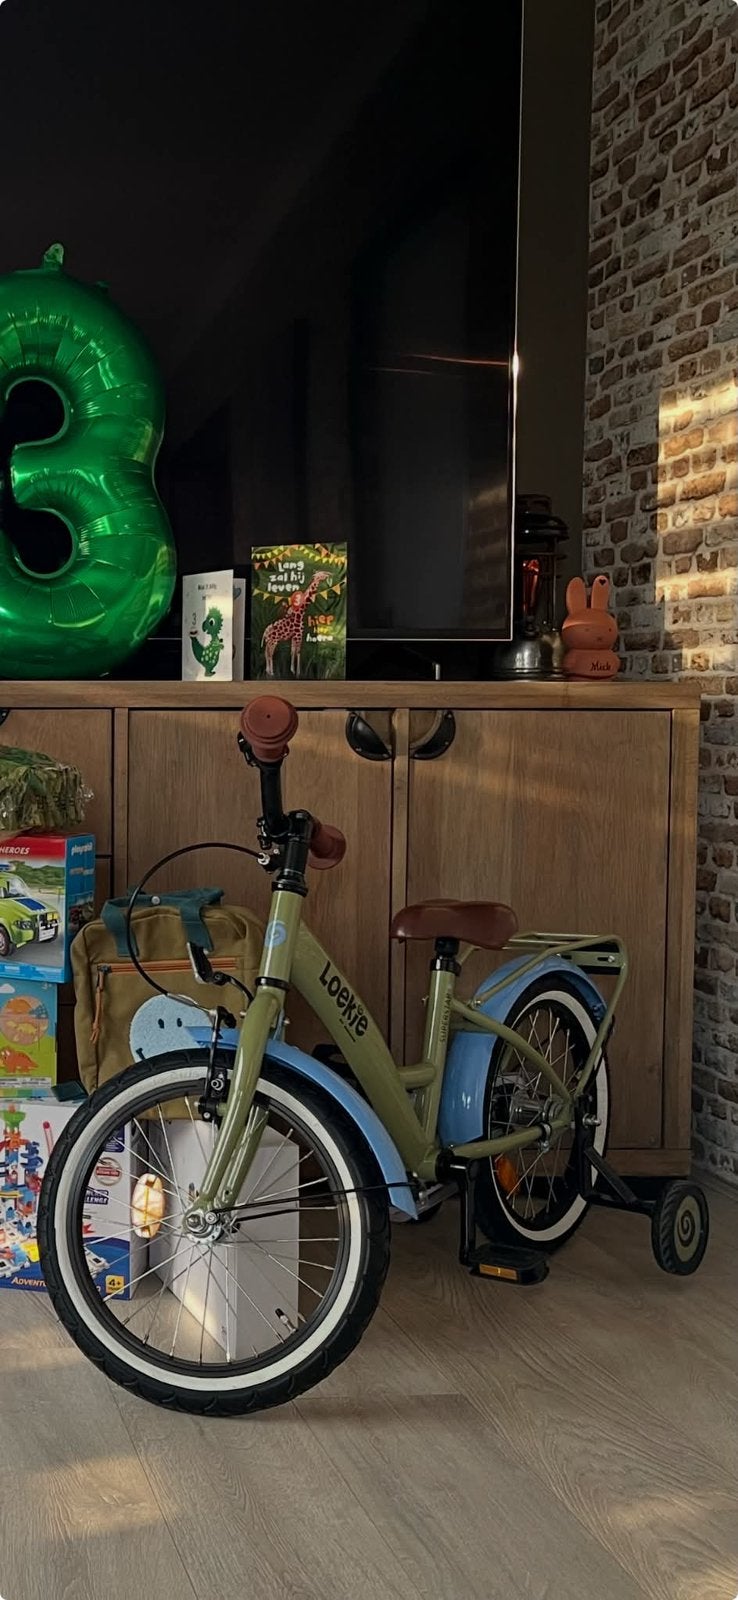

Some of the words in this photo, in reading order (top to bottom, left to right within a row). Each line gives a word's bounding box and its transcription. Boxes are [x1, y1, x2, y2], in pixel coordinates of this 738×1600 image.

[278, 560, 305, 572] Lang
[269, 572, 288, 582] zal
[290, 570, 305, 584] hij
[267, 582, 300, 593] leven
[307, 614, 334, 626] hiep
[590, 660, 611, 671] Mick
[0, 846, 30, 855] HEROES
[319, 960, 369, 1037] Loekie
[86, 1196, 108, 1204] LENGE
[11, 1276, 47, 1287] ADVENTU
[108, 1278, 121, 1287] 4+
